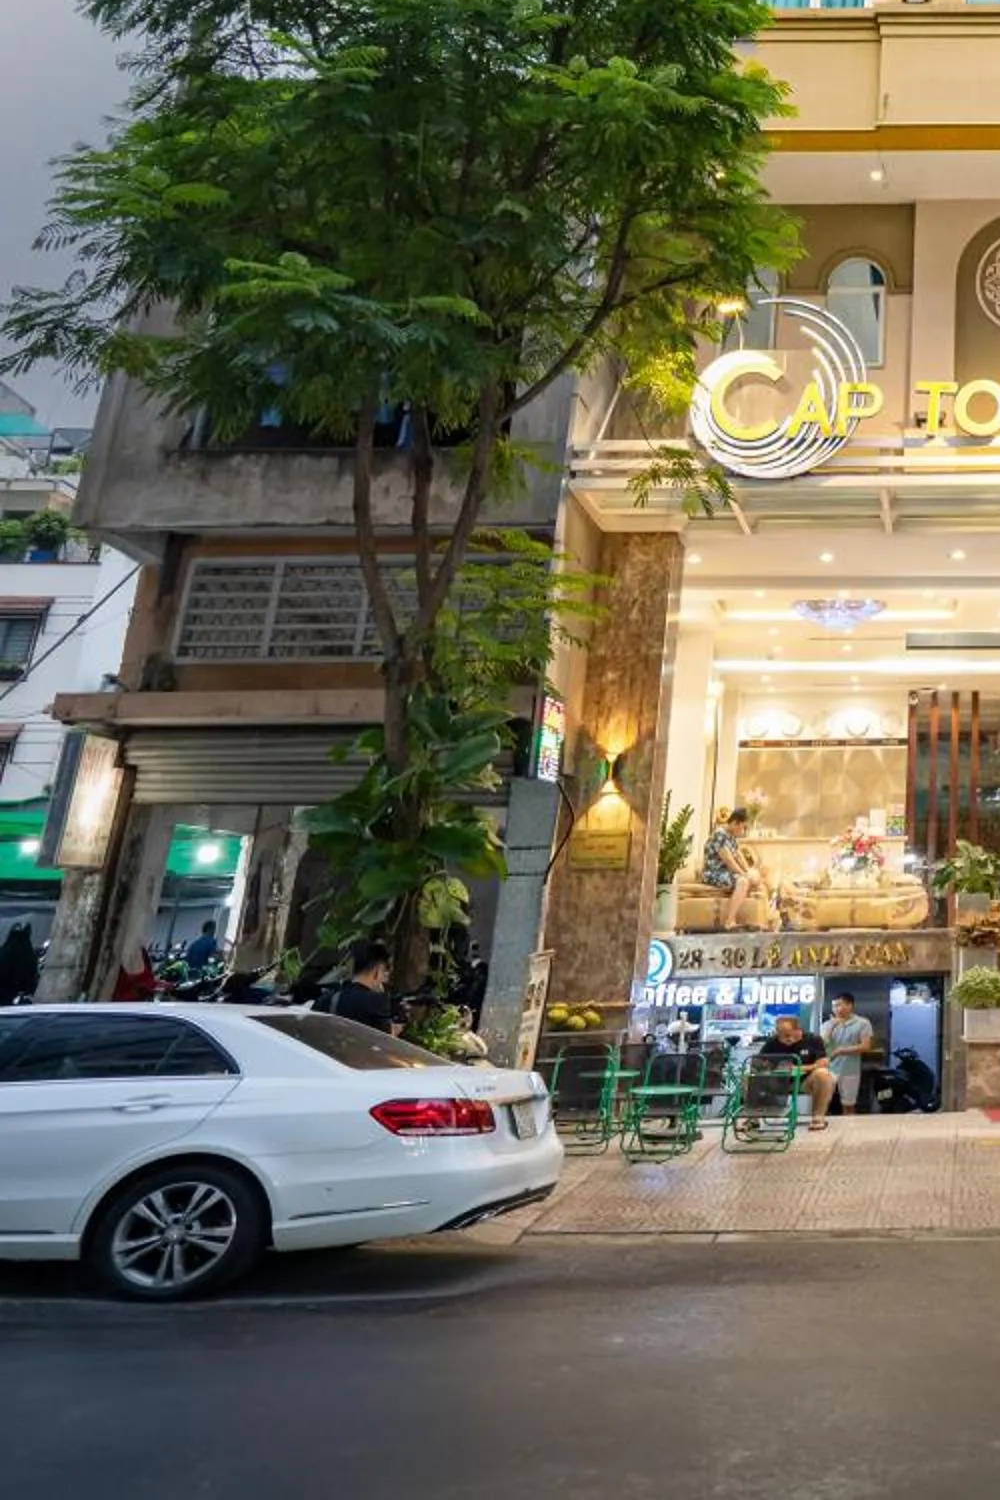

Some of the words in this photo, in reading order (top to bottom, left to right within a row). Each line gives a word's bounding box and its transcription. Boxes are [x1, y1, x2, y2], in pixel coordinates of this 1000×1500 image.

[710, 350, 884, 440] CAP
[679, 947, 702, 970] 28
[643, 982, 708, 1007] offee
[715, 983, 736, 1005] &
[743, 981, 816, 1006] Juice
